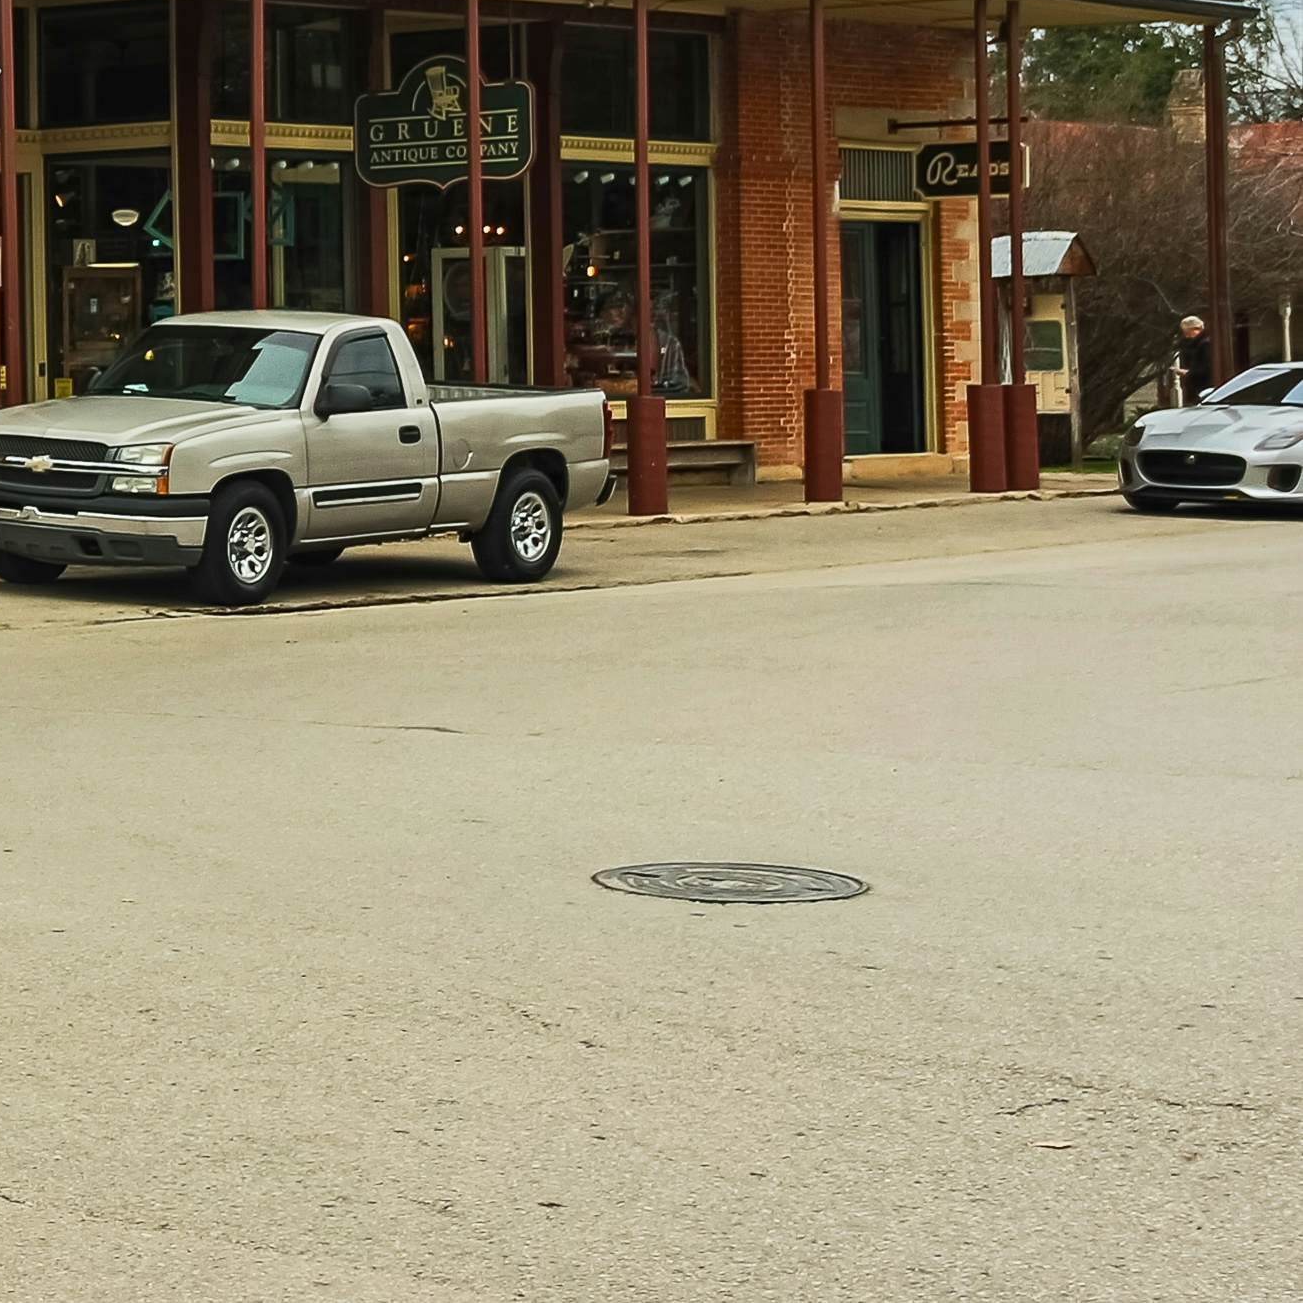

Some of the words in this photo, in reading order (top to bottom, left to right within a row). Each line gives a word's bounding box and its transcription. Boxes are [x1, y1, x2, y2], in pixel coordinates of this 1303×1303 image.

[369, 114, 519, 142] GRUENE
[370, 146, 439, 164] ANTIQUE
[445, 141, 519, 158] COPANY
